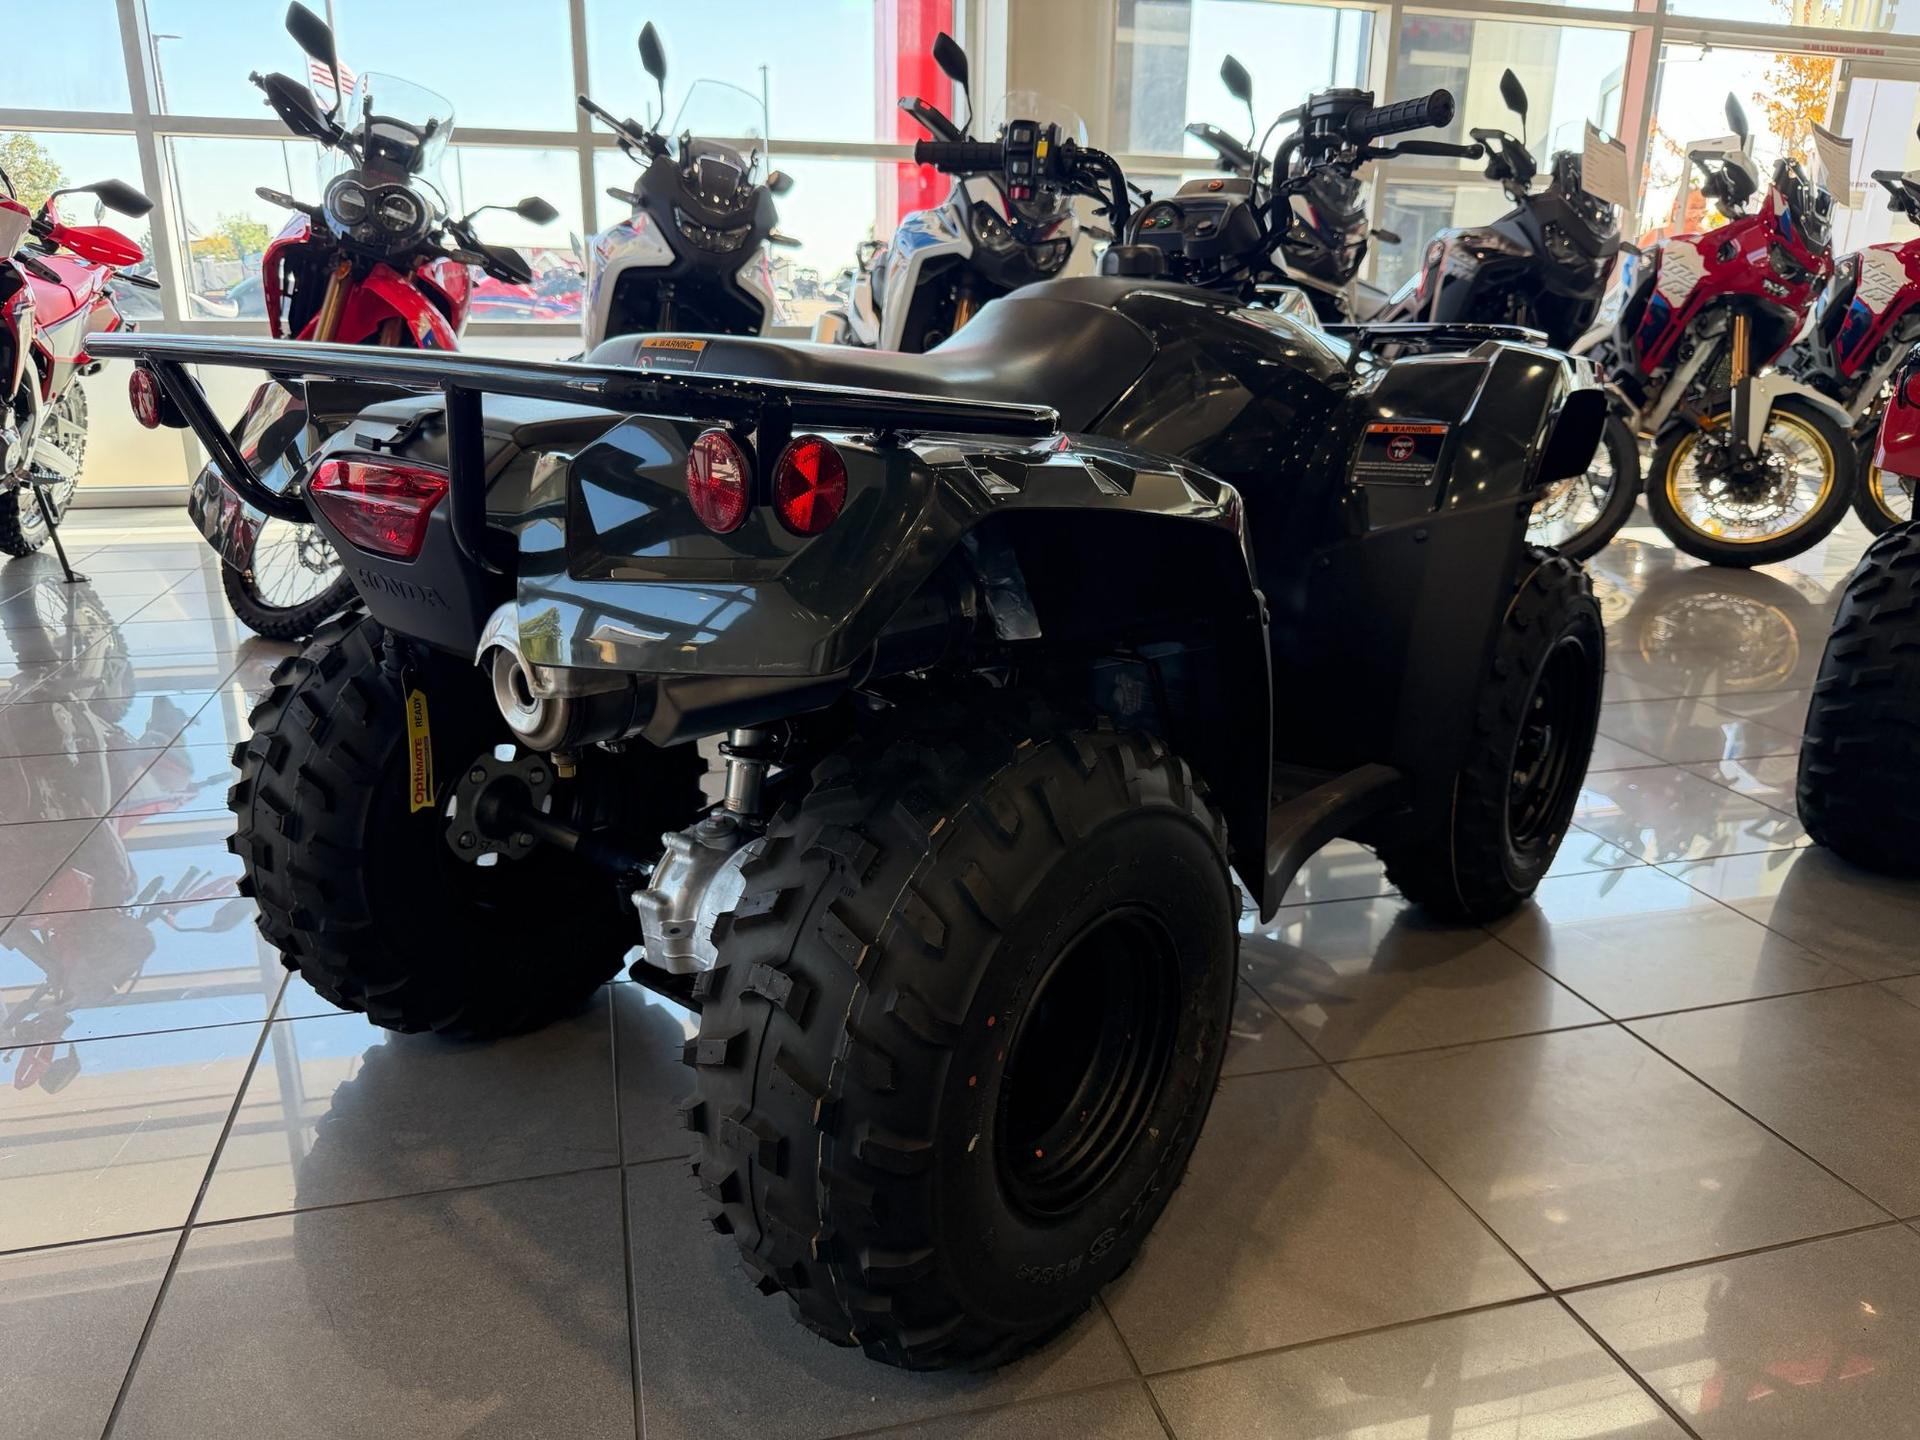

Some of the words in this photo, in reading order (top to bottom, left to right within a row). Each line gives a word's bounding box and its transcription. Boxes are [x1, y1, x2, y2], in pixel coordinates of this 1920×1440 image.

[660, 340, 694, 349] WARNING
[1392, 425, 1432, 433] WARNING
[1394, 449, 1406, 458] 16
[359, 568, 451, 611] HONDA
[413, 697, 424, 728] READY
[414, 737, 425, 804] OptiMATE
